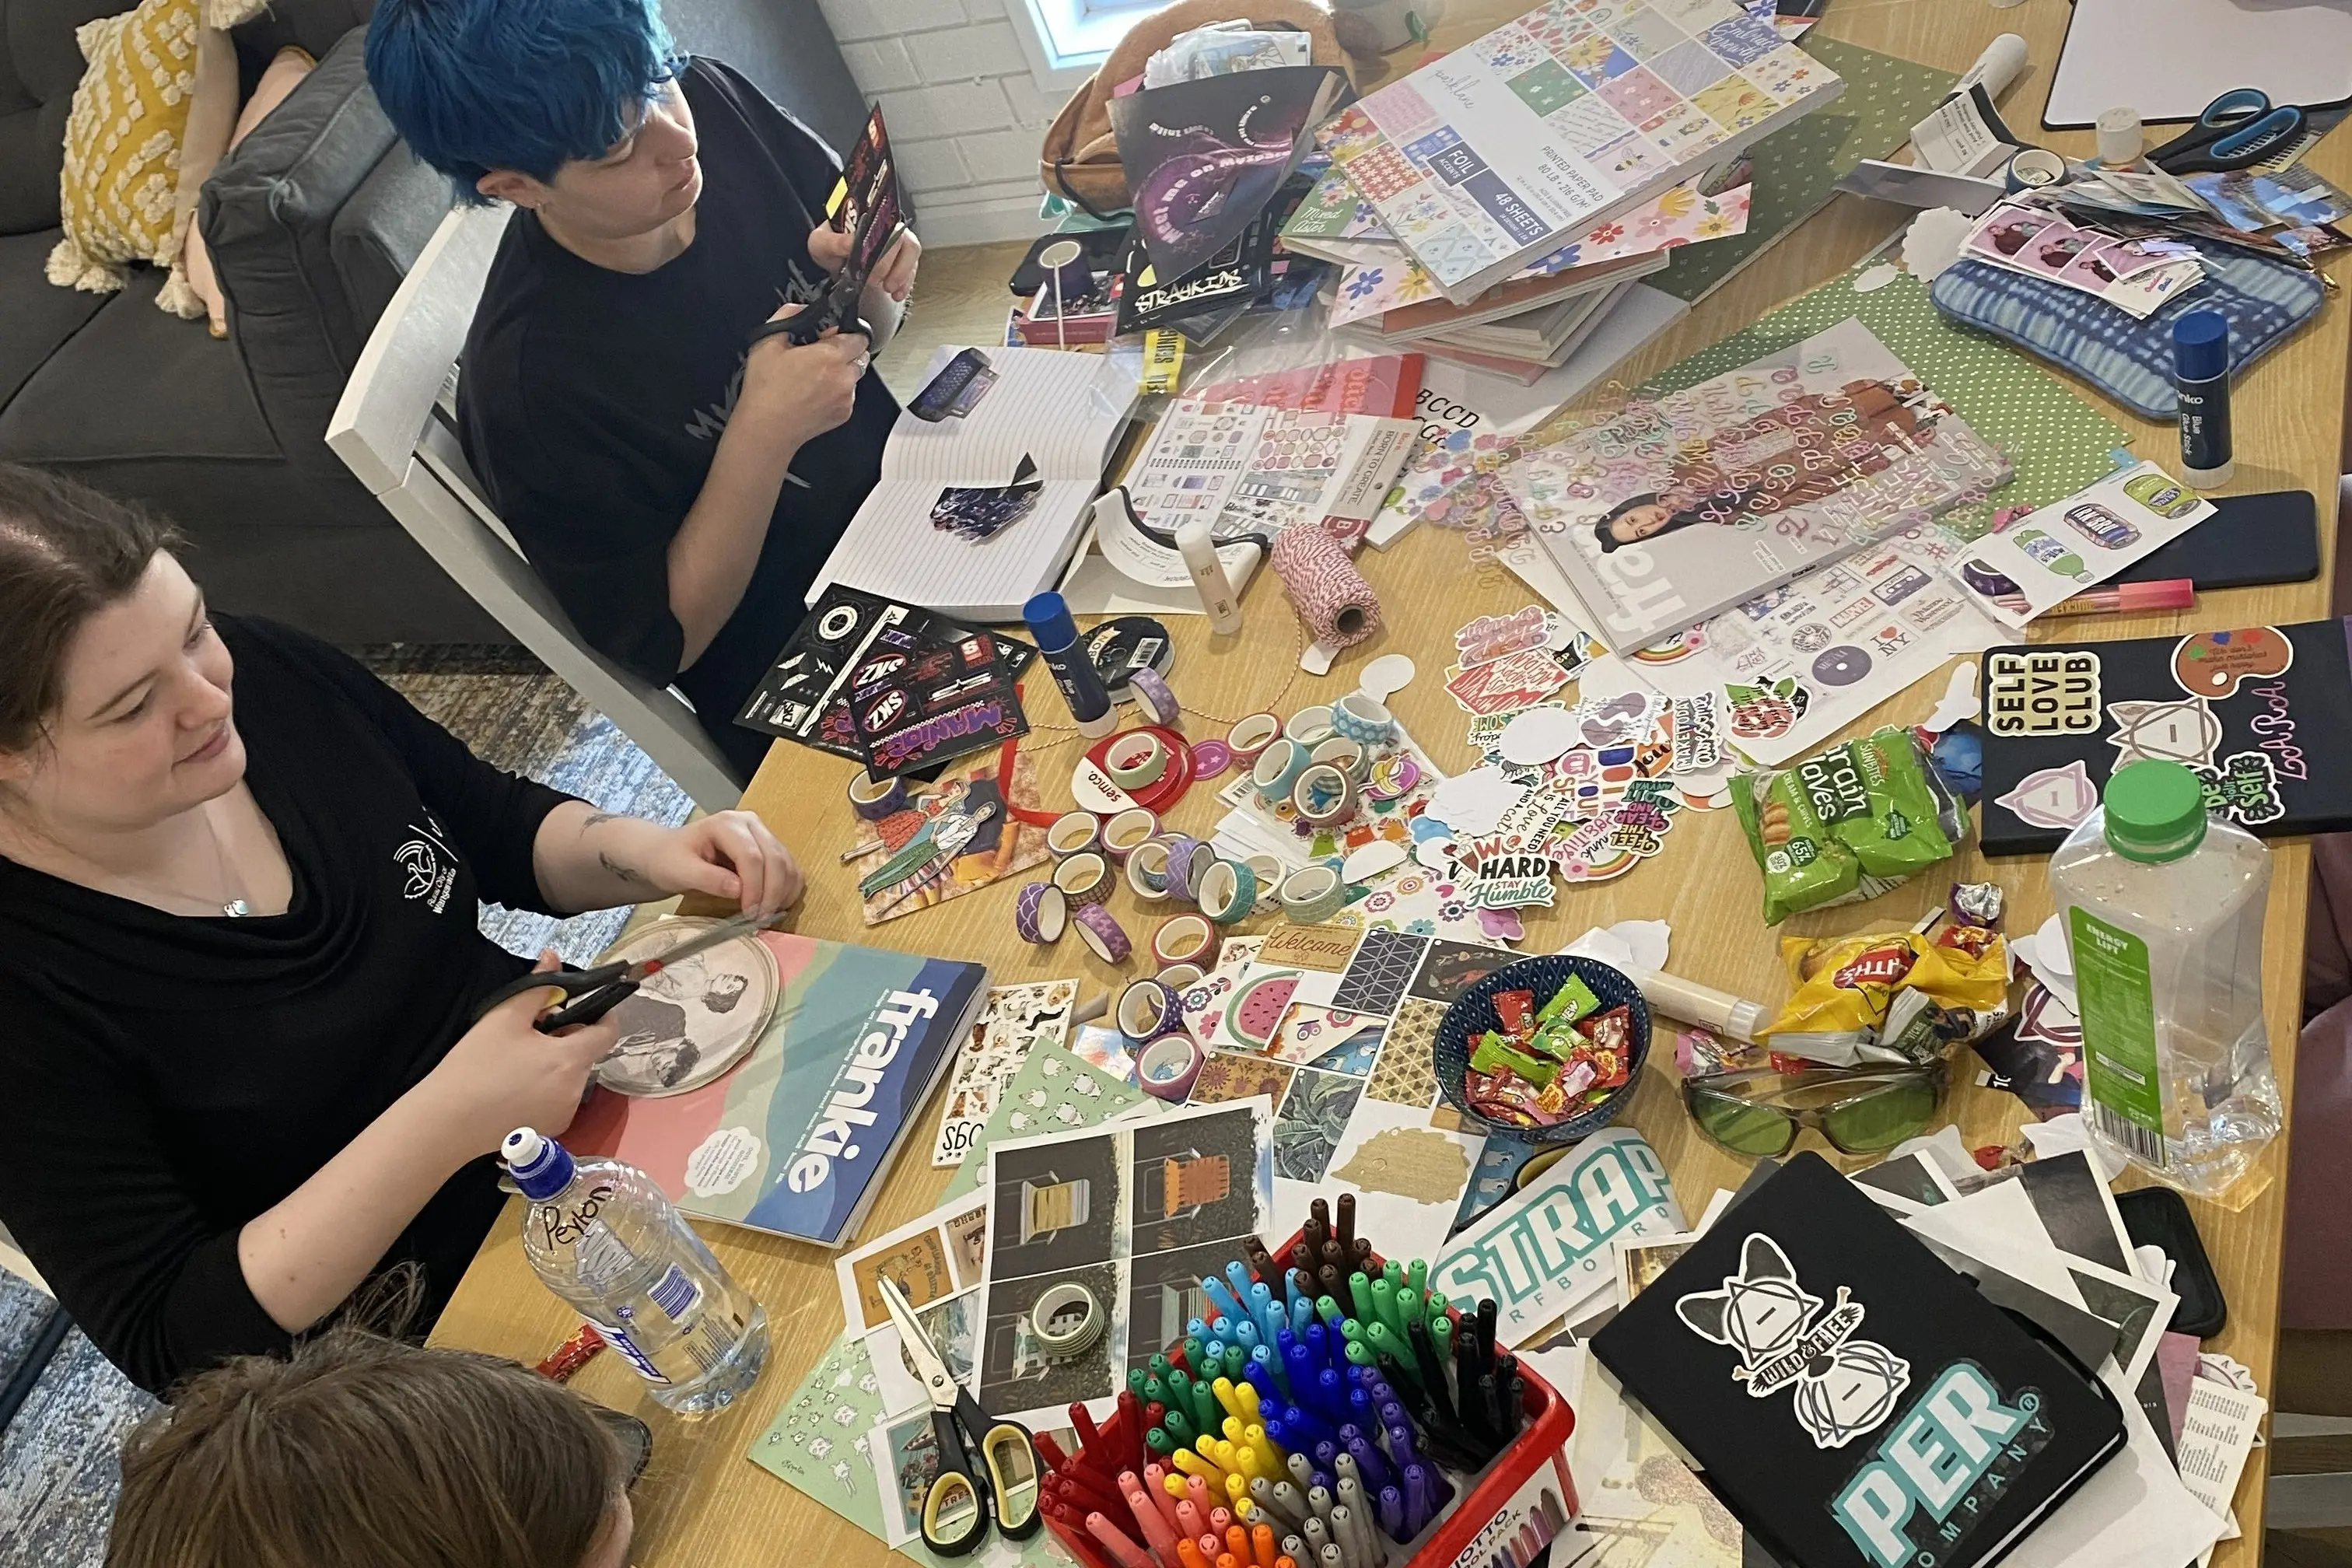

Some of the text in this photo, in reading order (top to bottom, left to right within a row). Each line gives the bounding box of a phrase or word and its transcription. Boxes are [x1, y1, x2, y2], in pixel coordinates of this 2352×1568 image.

[1440, 158, 1460, 180] ACCENTS
[1448, 149, 1474, 174] FOIL
[1542, 146, 1570, 171] PRINTED
[1570, 170, 1591, 191] PAPER
[1587, 187, 1604, 203] PAD
[1538, 164, 1548, 175] 80
[1548, 172, 1558, 182] LB
[1563, 184, 1573, 197] 216
[1292, 220, 1326, 233] Aster
[1300, 206, 1344, 219] Mixed
[1495, 192, 1514, 207] 48
[1507, 202, 1544, 236] SHEETS
[2182, 413, 2193, 456] Glue Stick
[2192, 415, 2203, 434] Blue
[1376, 430, 1395, 457] BORN
[1370, 456, 1382, 470] TO
[1347, 468, 1373, 505] CREATE
[1467, 607, 1537, 639] there is
[1832, 598, 1873, 627] MARVEL
[1870, 635, 1885, 647] I
[1878, 632, 1911, 656] NY
[1503, 651, 1554, 686] ACCIDEN
[1997, 660, 2025, 731] SELF
[2032, 658, 2059, 731] LOVE
[2065, 657, 2092, 729] CLUB
[1472, 714, 1507, 732] SOME
[1674, 698, 1692, 771] MAKE TODAY
[1860, 739, 1885, 787] SUNBITES
[1087, 771, 1122, 805] semco.
[1519, 789, 1535, 803] AND
[1544, 793, 1554, 802] IS
[1626, 781, 1675, 791] ANYWAY
[1516, 798, 1548, 834] Love
[1614, 809, 1670, 831] FEAR
[1626, 801, 1654, 813] AND
[1796, 802, 1813, 829] CHIVES
[1527, 796, 1570, 850] ALL YOU NEED
[1620, 824, 1646, 835] THE
[1474, 835, 1555, 860] WK
[1580, 835, 1609, 863] ink
[1610, 832, 1661, 854] FEEL
[1790, 840, 1809, 863] 65%
[1480, 856, 1546, 880] HARD
[427, 889, 440, 907] Rural
[436, 873, 446, 888] City
[432, 868, 457, 914] Wangaratta
[1467, 878, 1553, 907] Humble
[1494, 880, 1521, 890] STAY
[1268, 931, 1353, 959] Welcome
[1843, 958, 1901, 979] ITH'S
[787, 987, 941, 1193] frankie
[942, 1122, 985, 1153] ogs
[544, 1187, 612, 1251] Peyton
[1430, 1139, 1671, 1313] STRAP
[1762, 1349, 1803, 1386] WILD
[1815, 1310, 1853, 1356] FREE
[1836, 1365, 2024, 1567] PER
[1918, 1419, 2049, 1568] OMPANY
[1451, 1509, 1507, 1568] IOTTO
[1489, 1508, 1522, 1547] PACK
